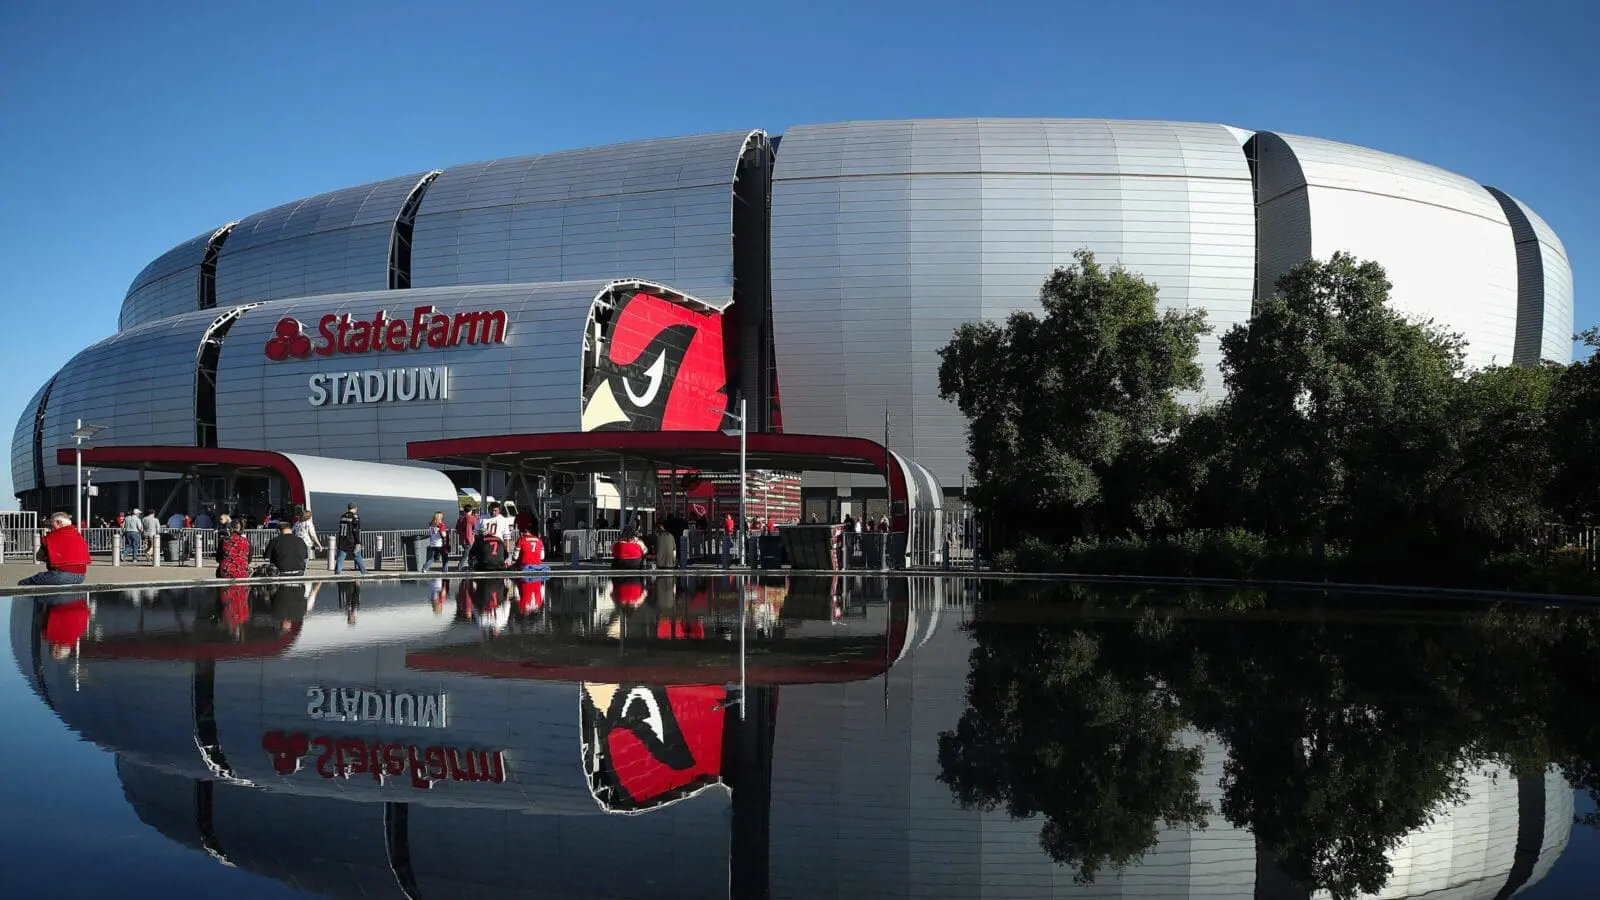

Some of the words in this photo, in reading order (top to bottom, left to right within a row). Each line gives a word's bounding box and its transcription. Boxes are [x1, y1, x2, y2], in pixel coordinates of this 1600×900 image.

[308, 367, 448, 406] STADIUM
[486, 521, 498, 535] 10
[530, 541, 537, 553] 7
